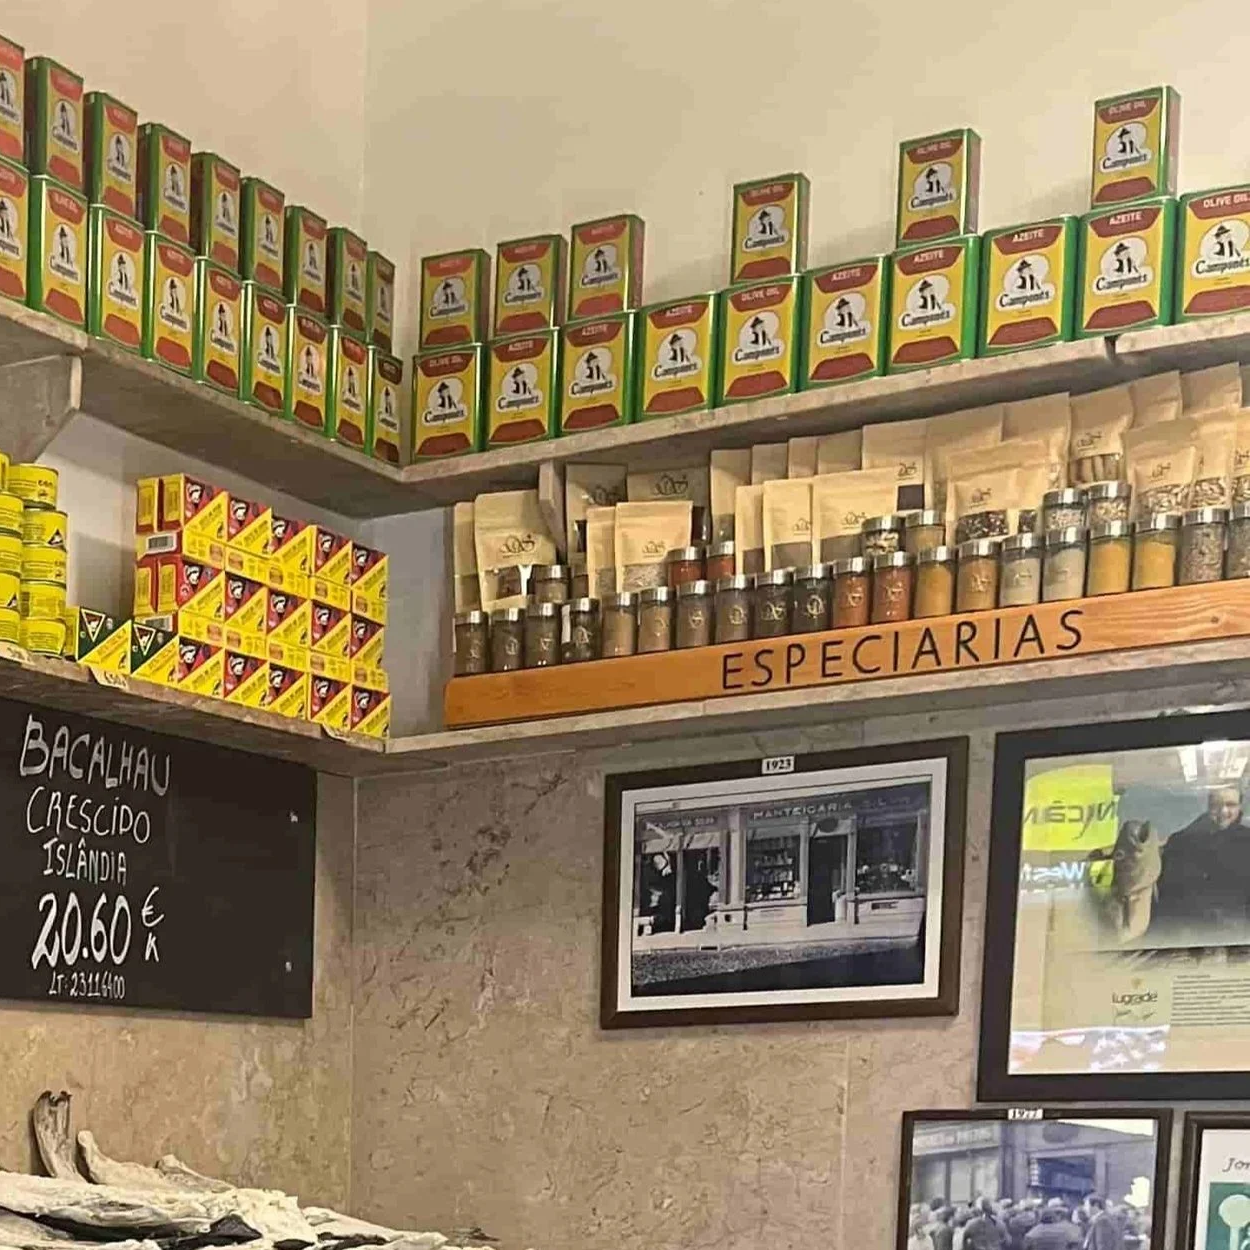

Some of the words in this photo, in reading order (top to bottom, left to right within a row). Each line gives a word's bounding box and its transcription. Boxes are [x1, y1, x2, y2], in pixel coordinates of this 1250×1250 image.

[1203, 195, 1231, 209] OLIVE
[1233, 191, 1250, 205] OIL
[1109, 211, 1143, 226] AZEITE
[1012, 228, 1044, 244] AZEITE
[913, 250, 944, 264] AZEITE
[831, 268, 861, 282] AZEITE
[722, 609, 1085, 691] ESPECIARIAS
[20, 713, 171, 796] BACALHAU
[764, 758, 792, 772] 1923
[26, 786, 151, 844] CRESCIDO
[43, 837, 127, 885] ISLÂNDIA
[31, 891, 132, 970] 20.60
[141, 886, 165, 927] €
